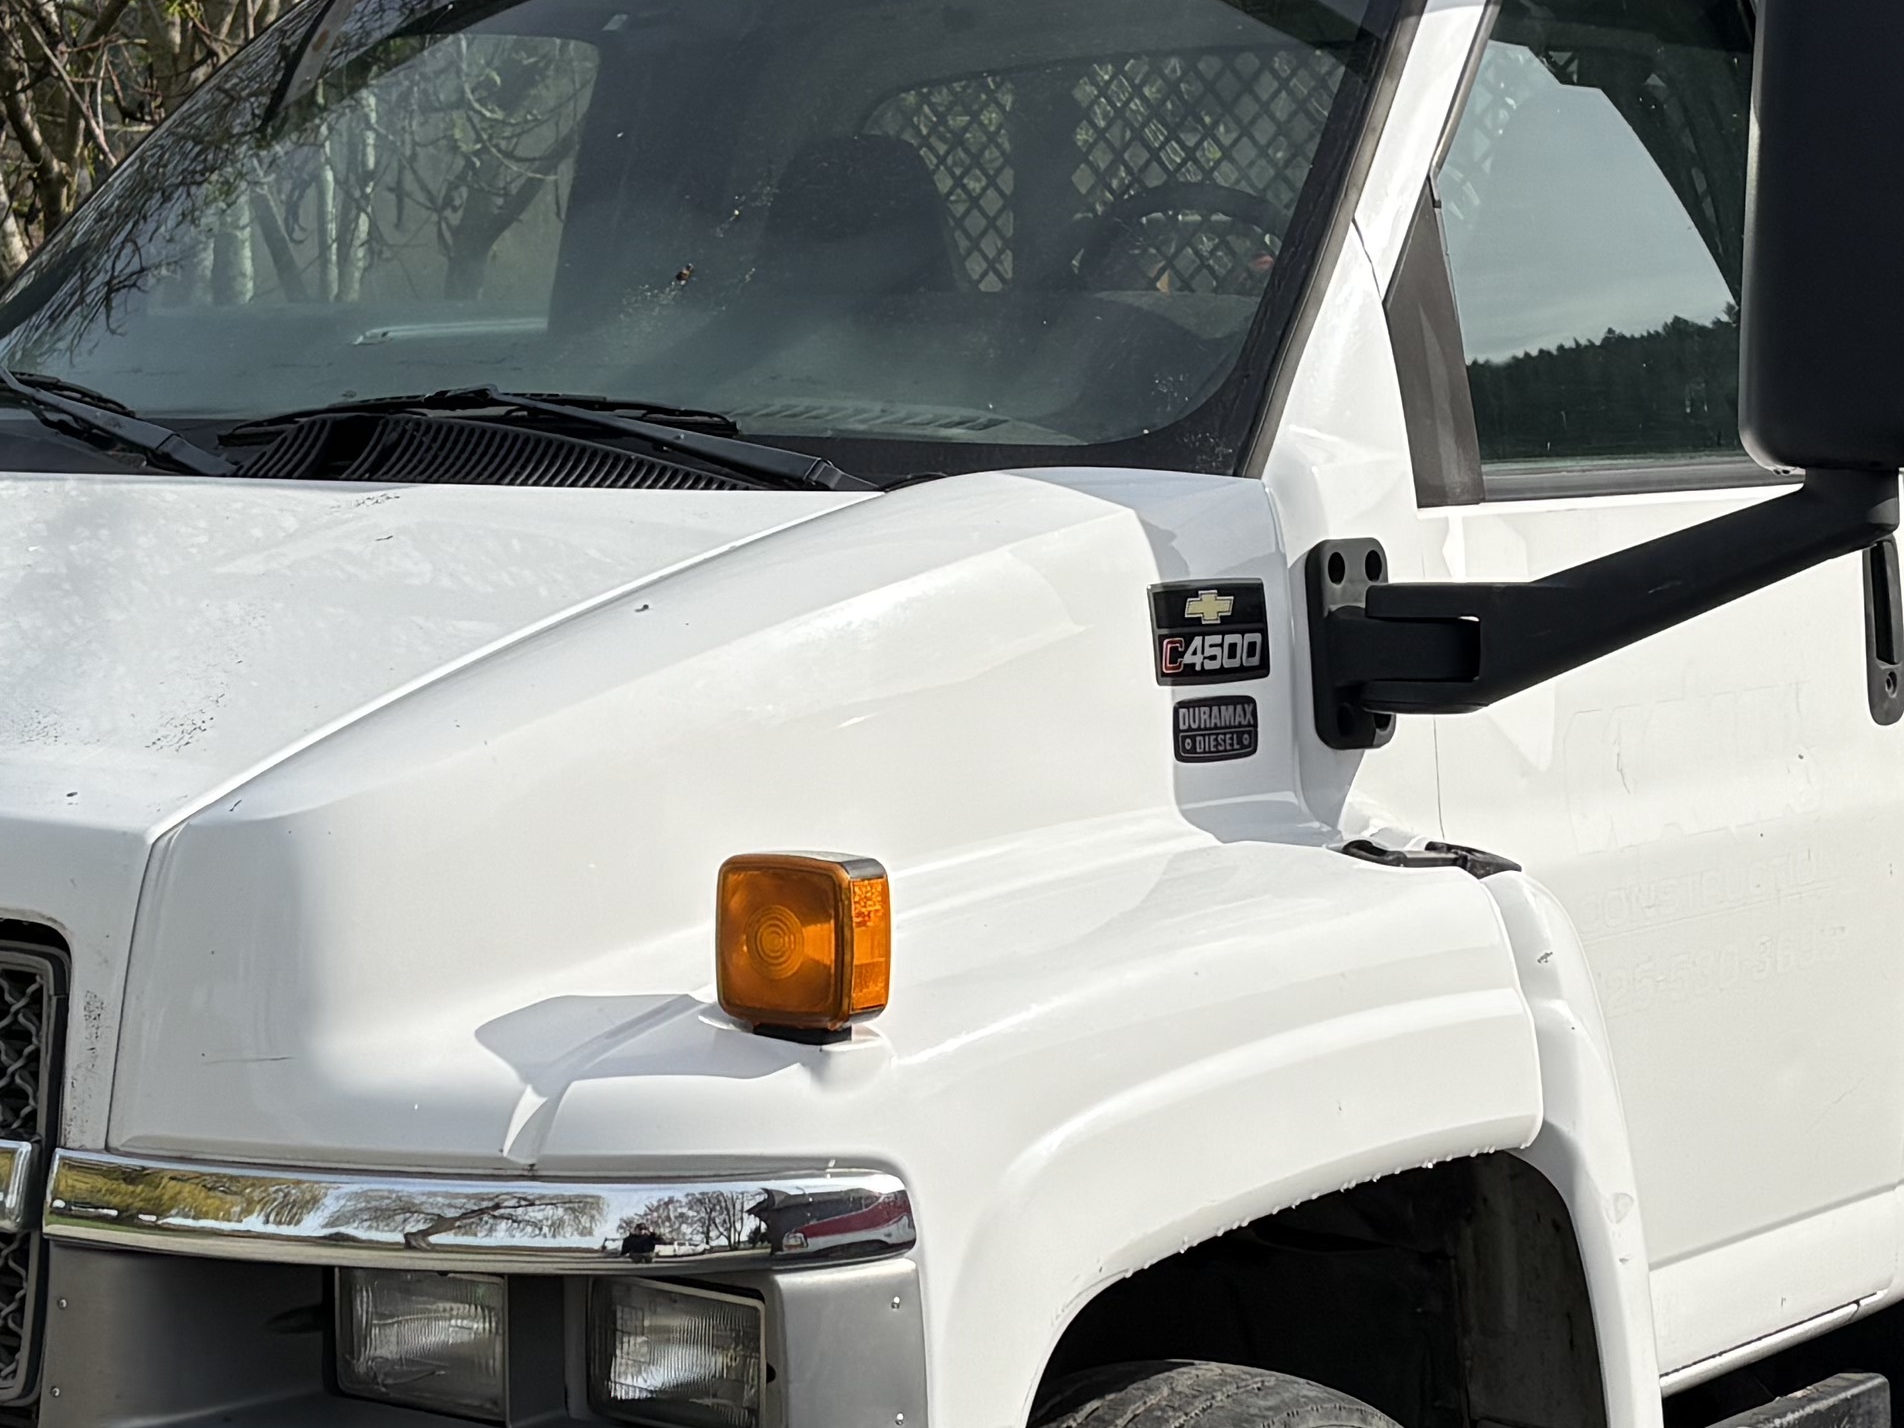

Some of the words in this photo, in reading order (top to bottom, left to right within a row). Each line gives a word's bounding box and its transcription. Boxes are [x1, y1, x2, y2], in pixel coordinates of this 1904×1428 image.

[1162, 632, 1262, 673] C4500
[1179, 703, 1255, 730] DURAMAX
[1195, 735, 1240, 753] DIESEL
